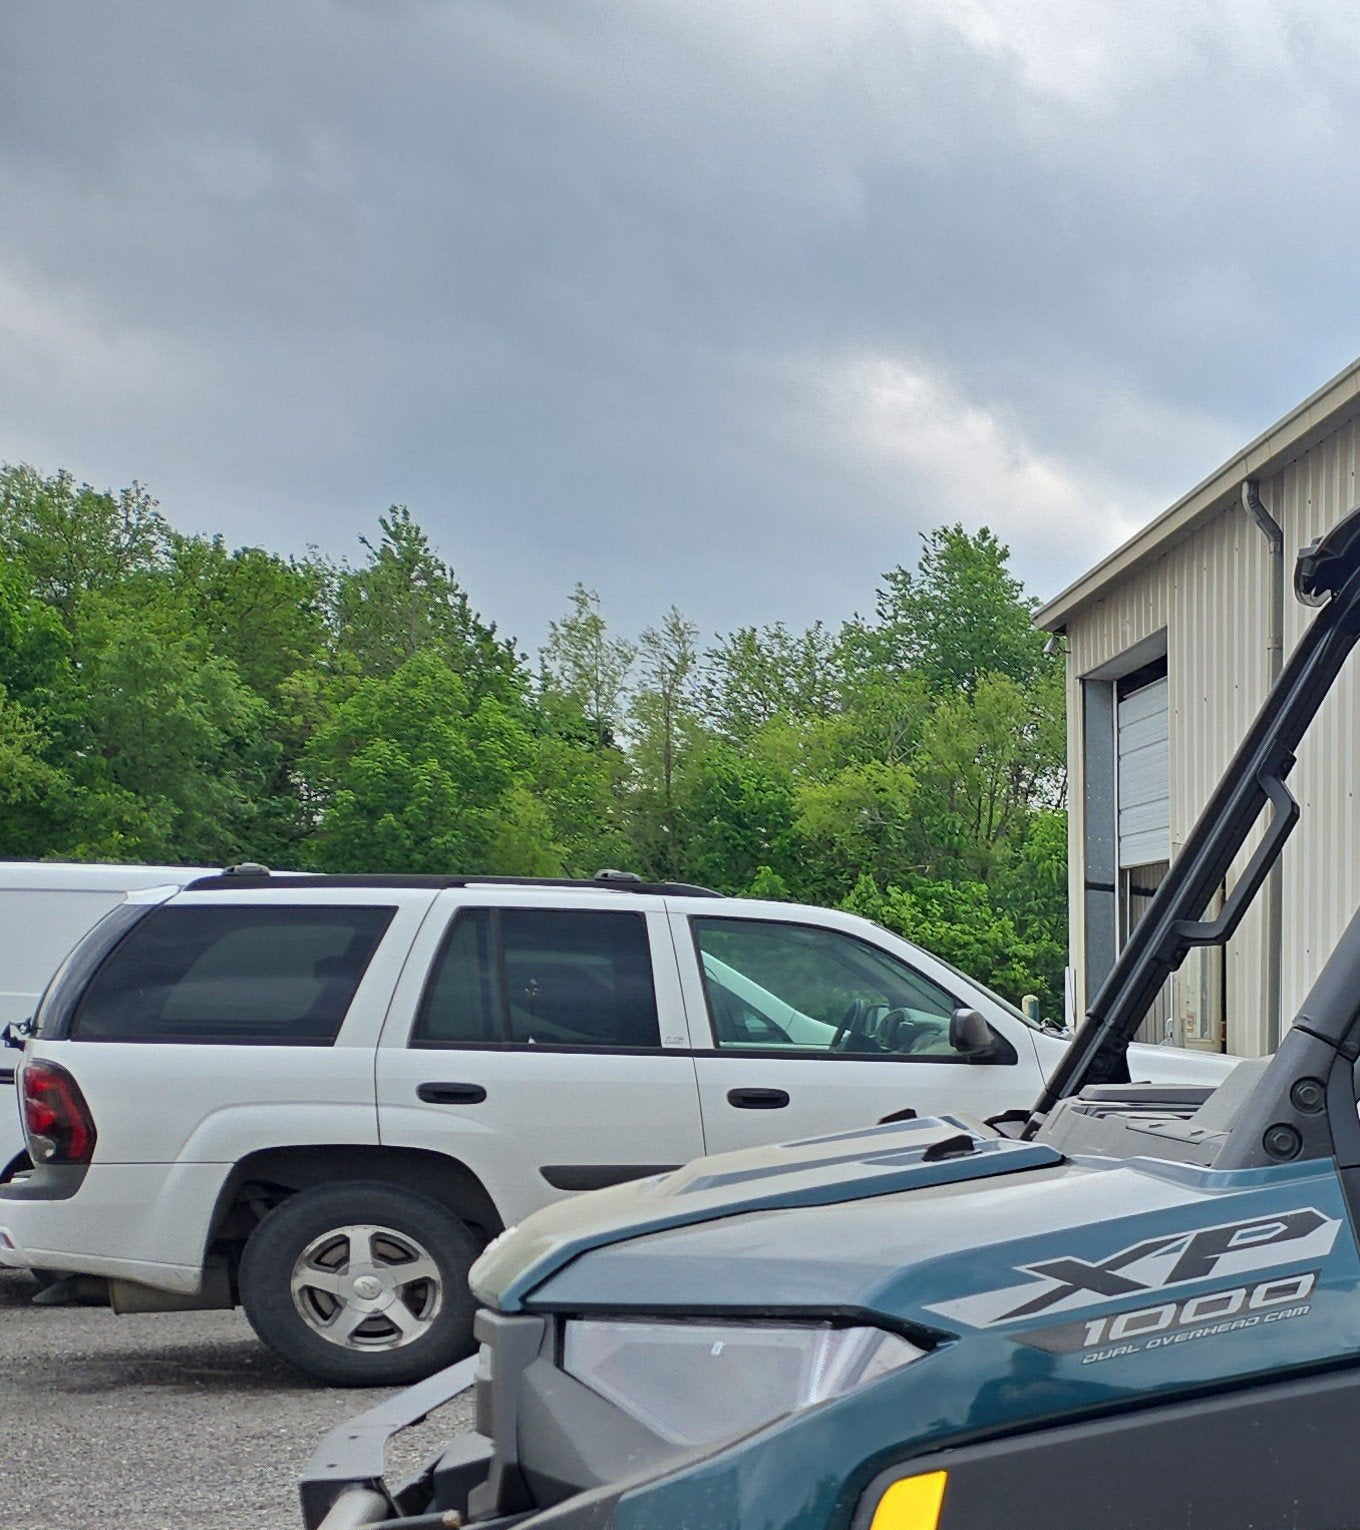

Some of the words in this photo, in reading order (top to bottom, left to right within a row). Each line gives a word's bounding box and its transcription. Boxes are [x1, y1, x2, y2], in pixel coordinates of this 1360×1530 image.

[986, 1207, 1331, 1324] XP
[1082, 1344, 1140, 1365] DUAL
[1146, 1316, 1260, 1350] OVERHEAD
[1264, 1305, 1312, 1323] CAM
[1083, 1273, 1316, 1347] 1000
